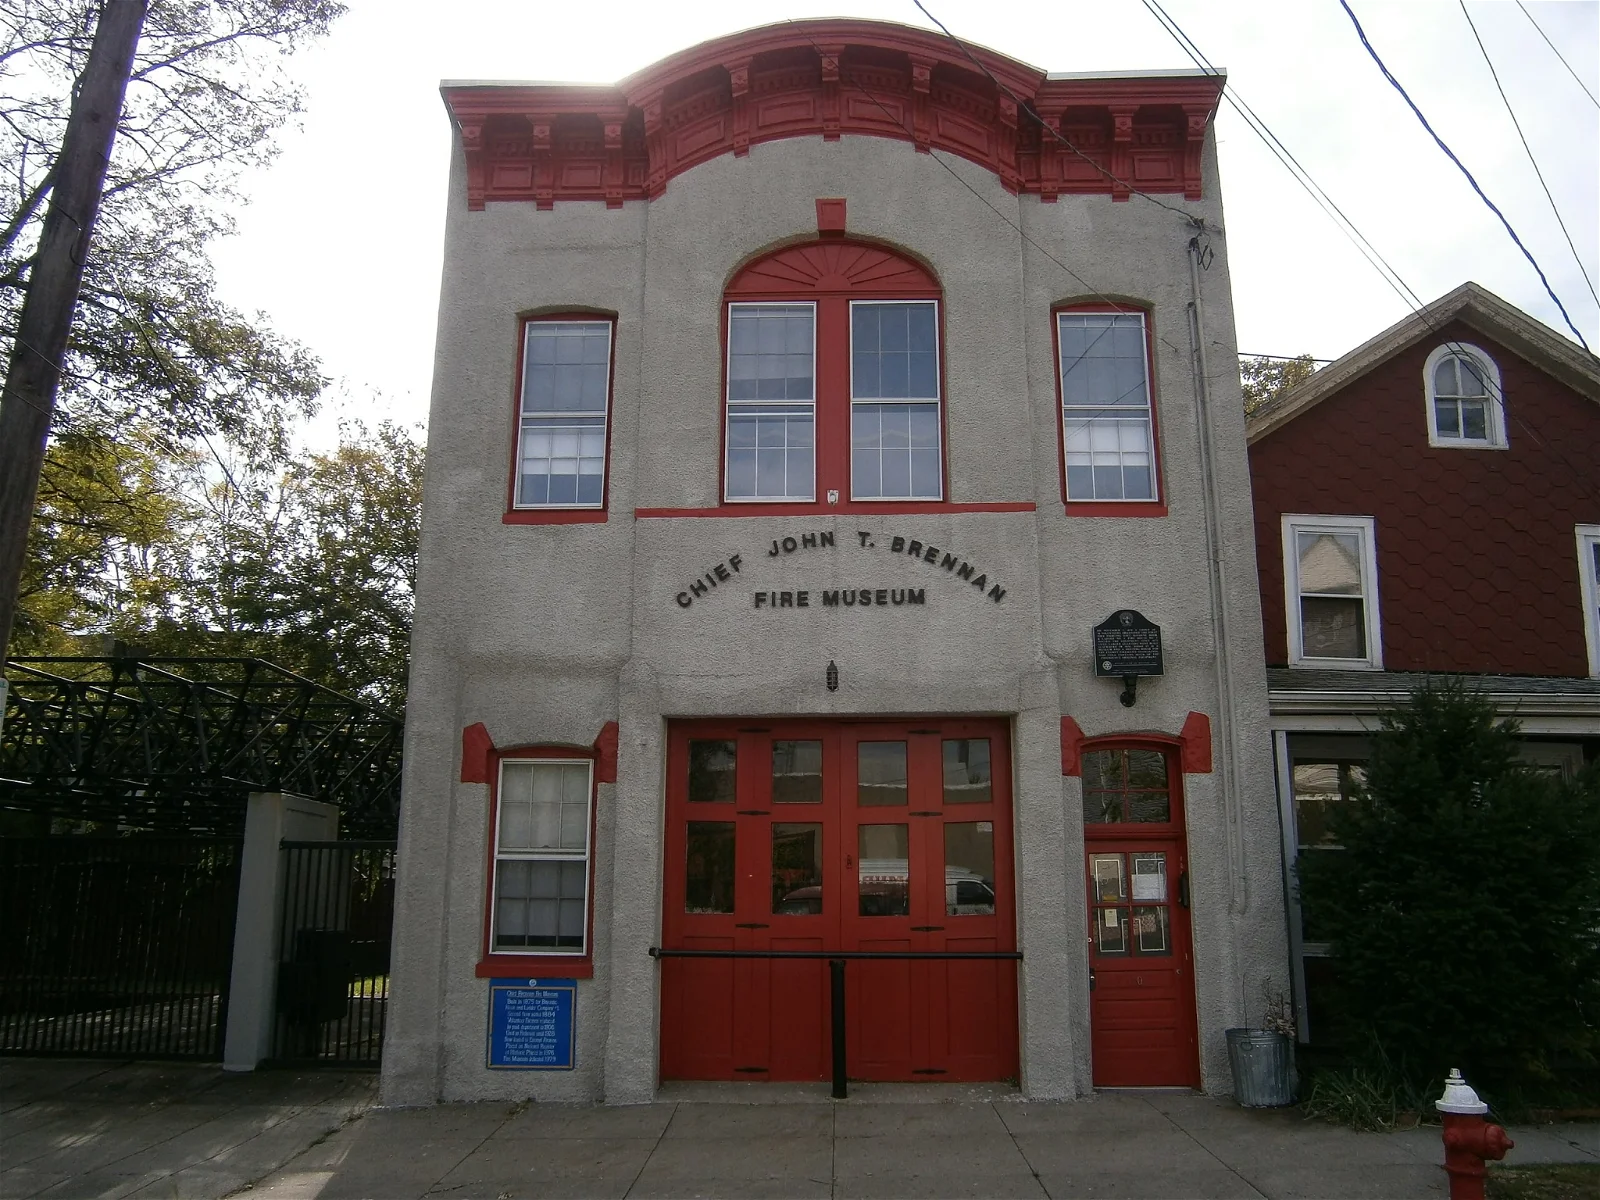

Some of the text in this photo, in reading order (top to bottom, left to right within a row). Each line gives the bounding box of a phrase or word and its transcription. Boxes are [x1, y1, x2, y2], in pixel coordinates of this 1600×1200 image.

[676, 531, 1007, 609] CHIEF JOHN T. BRENNAN
[754, 588, 926, 609] FIRE MUSEUM
